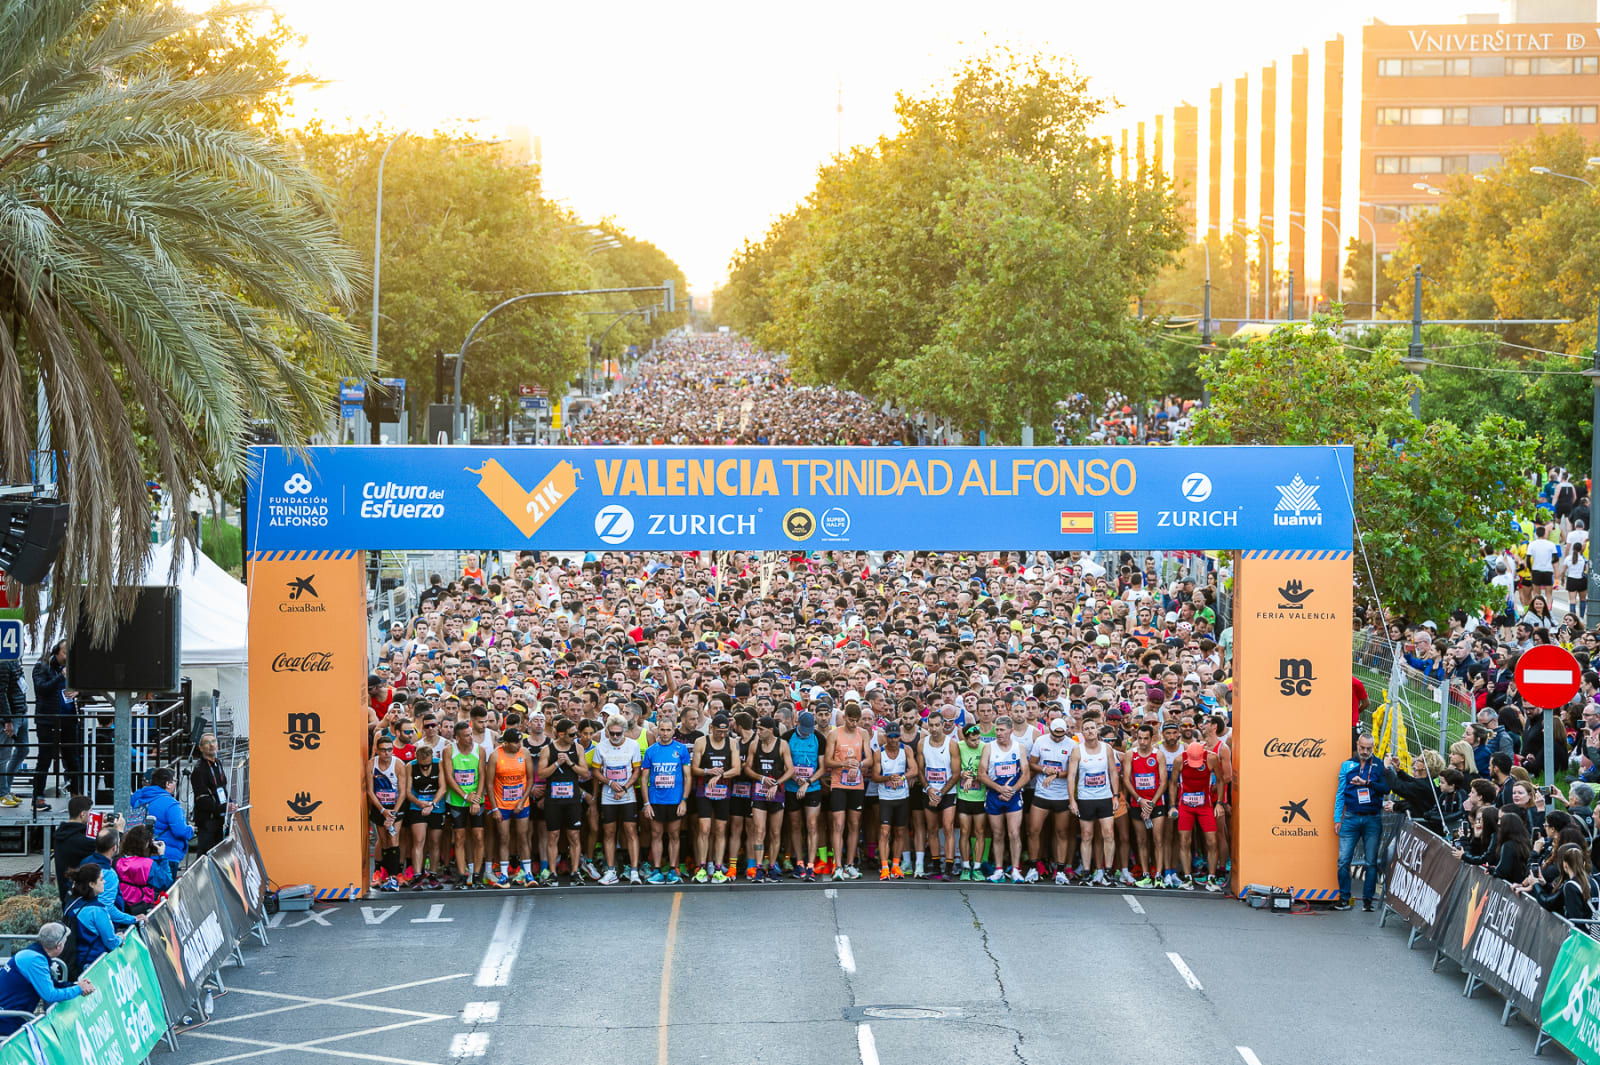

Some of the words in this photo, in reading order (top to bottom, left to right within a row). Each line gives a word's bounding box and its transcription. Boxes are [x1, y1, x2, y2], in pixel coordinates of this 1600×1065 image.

[1408, 30, 1553, 52] VNIVERSITAT
[595, 459, 779, 496] VALENCIA
[782, 459, 953, 496] TRINIDAD
[958, 459, 1137, 496] ALFONSO
[363, 481, 428, 500] Cultura
[429, 488, 445, 499] del
[269, 495, 328, 504] FUNDACIÓN
[526, 480, 563, 524] 21K
[269, 506, 329, 516] TRINIDAD
[360, 500, 445, 519] Esfuerzo
[269, 516, 329, 527] ALFONSO
[647, 513, 756, 536] ZURICH
[1157, 510, 1238, 527] ZURICH
[278, 603, 326, 613] CaixaBank
[1289, 612, 1336, 620] VALENCIA
[265, 825, 294, 833] FERIA
[298, 824, 345, 832] VALENCIA
[1271, 827, 1319, 837] CaixaBank
